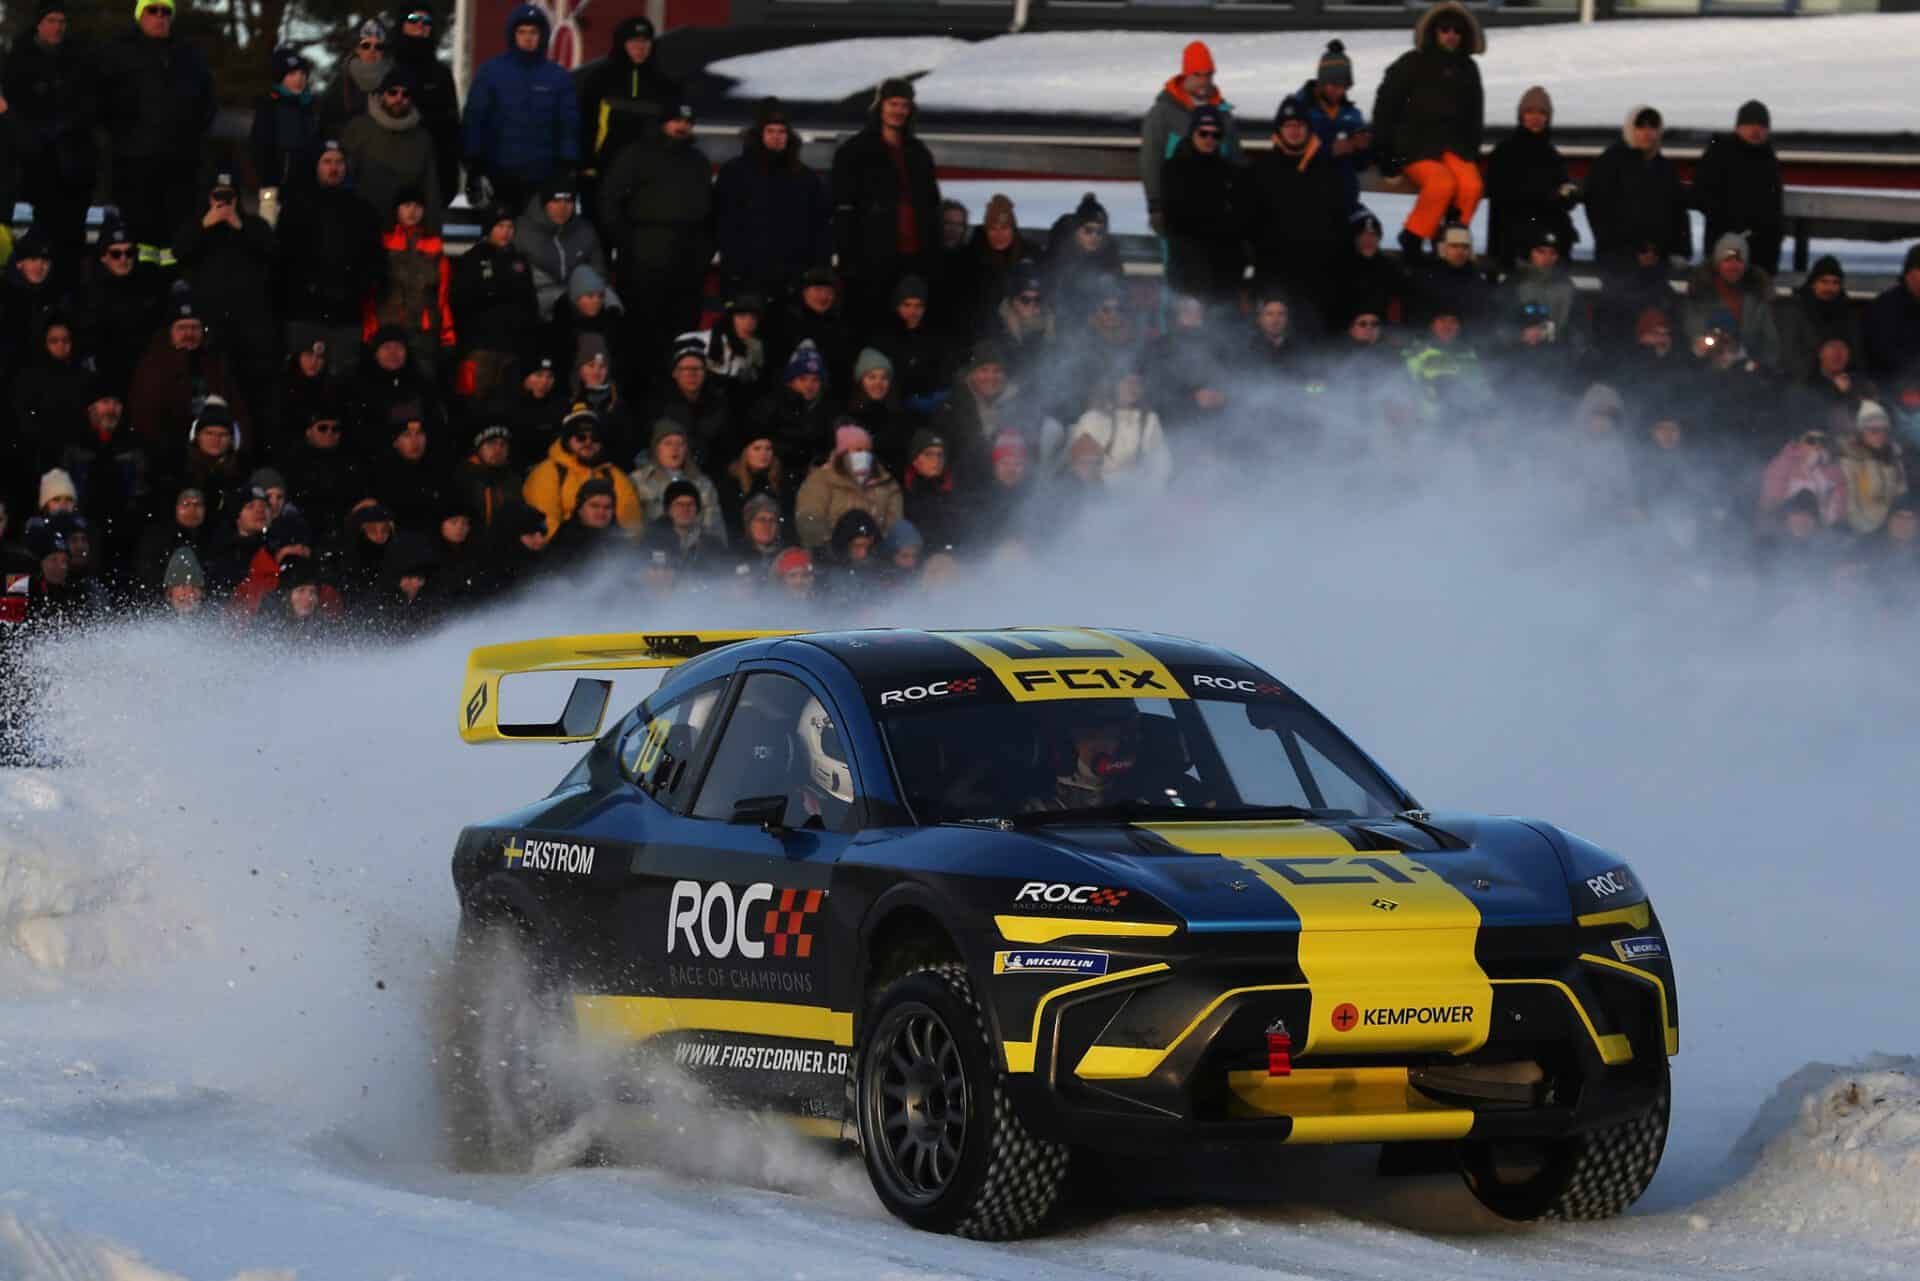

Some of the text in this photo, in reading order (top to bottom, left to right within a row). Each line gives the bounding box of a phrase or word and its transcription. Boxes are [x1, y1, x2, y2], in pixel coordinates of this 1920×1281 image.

[881, 681, 948, 705] ROC
[1193, 674, 1257, 693] ROC
[521, 839, 595, 875] EKSTROM
[1015, 881, 1098, 904] ROC
[1586, 871, 1624, 898] ROC
[667, 880, 774, 959] ROC
[1025, 957, 1094, 968] MICHELIN
[669, 965, 813, 993] RACE OF CHAMPIONS
[1364, 1005, 1473, 1026] KEMPOWER
[674, 1042, 850, 1075] WWW.FIRSTCORNER.CO
